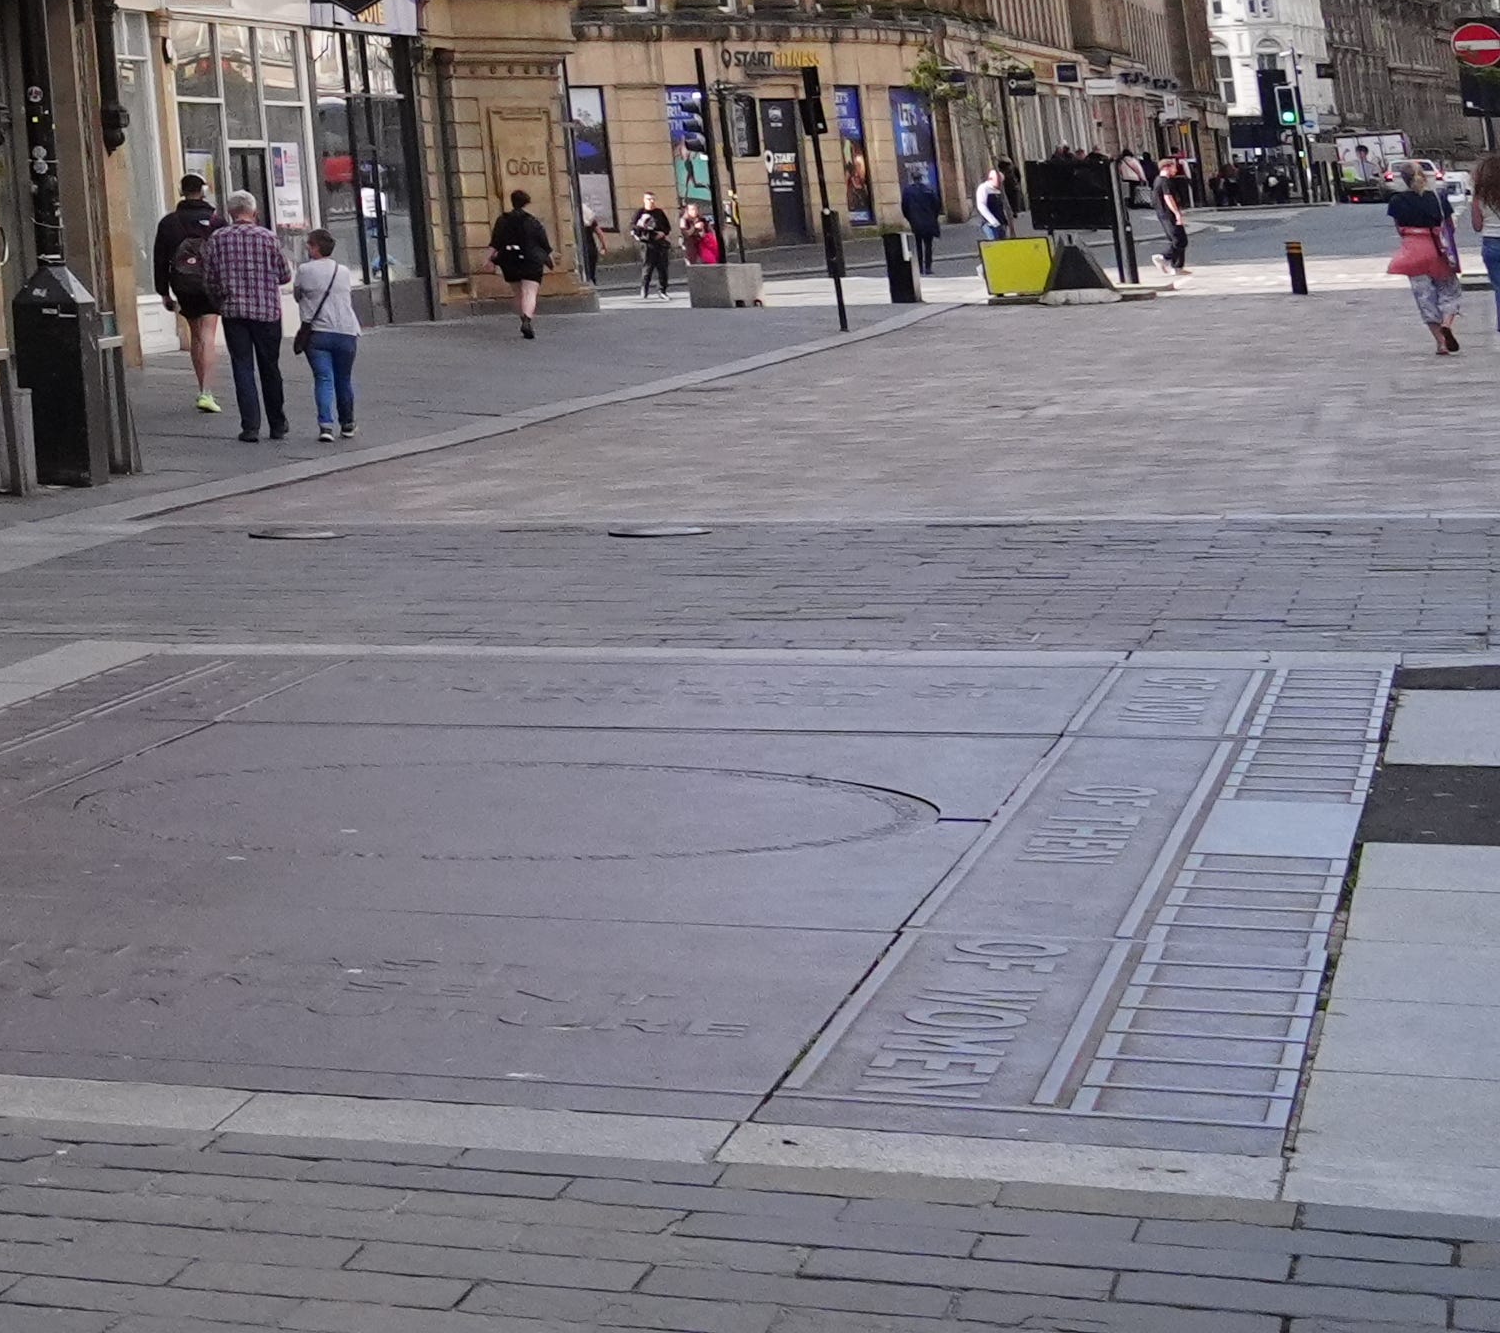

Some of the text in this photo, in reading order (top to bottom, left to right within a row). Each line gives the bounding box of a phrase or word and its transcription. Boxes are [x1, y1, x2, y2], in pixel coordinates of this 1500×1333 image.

[506, 156, 547, 176] CÔTE
[1013, 784, 1159, 865] OF THEN
[849, 938, 1069, 1100] OF WOMEN
